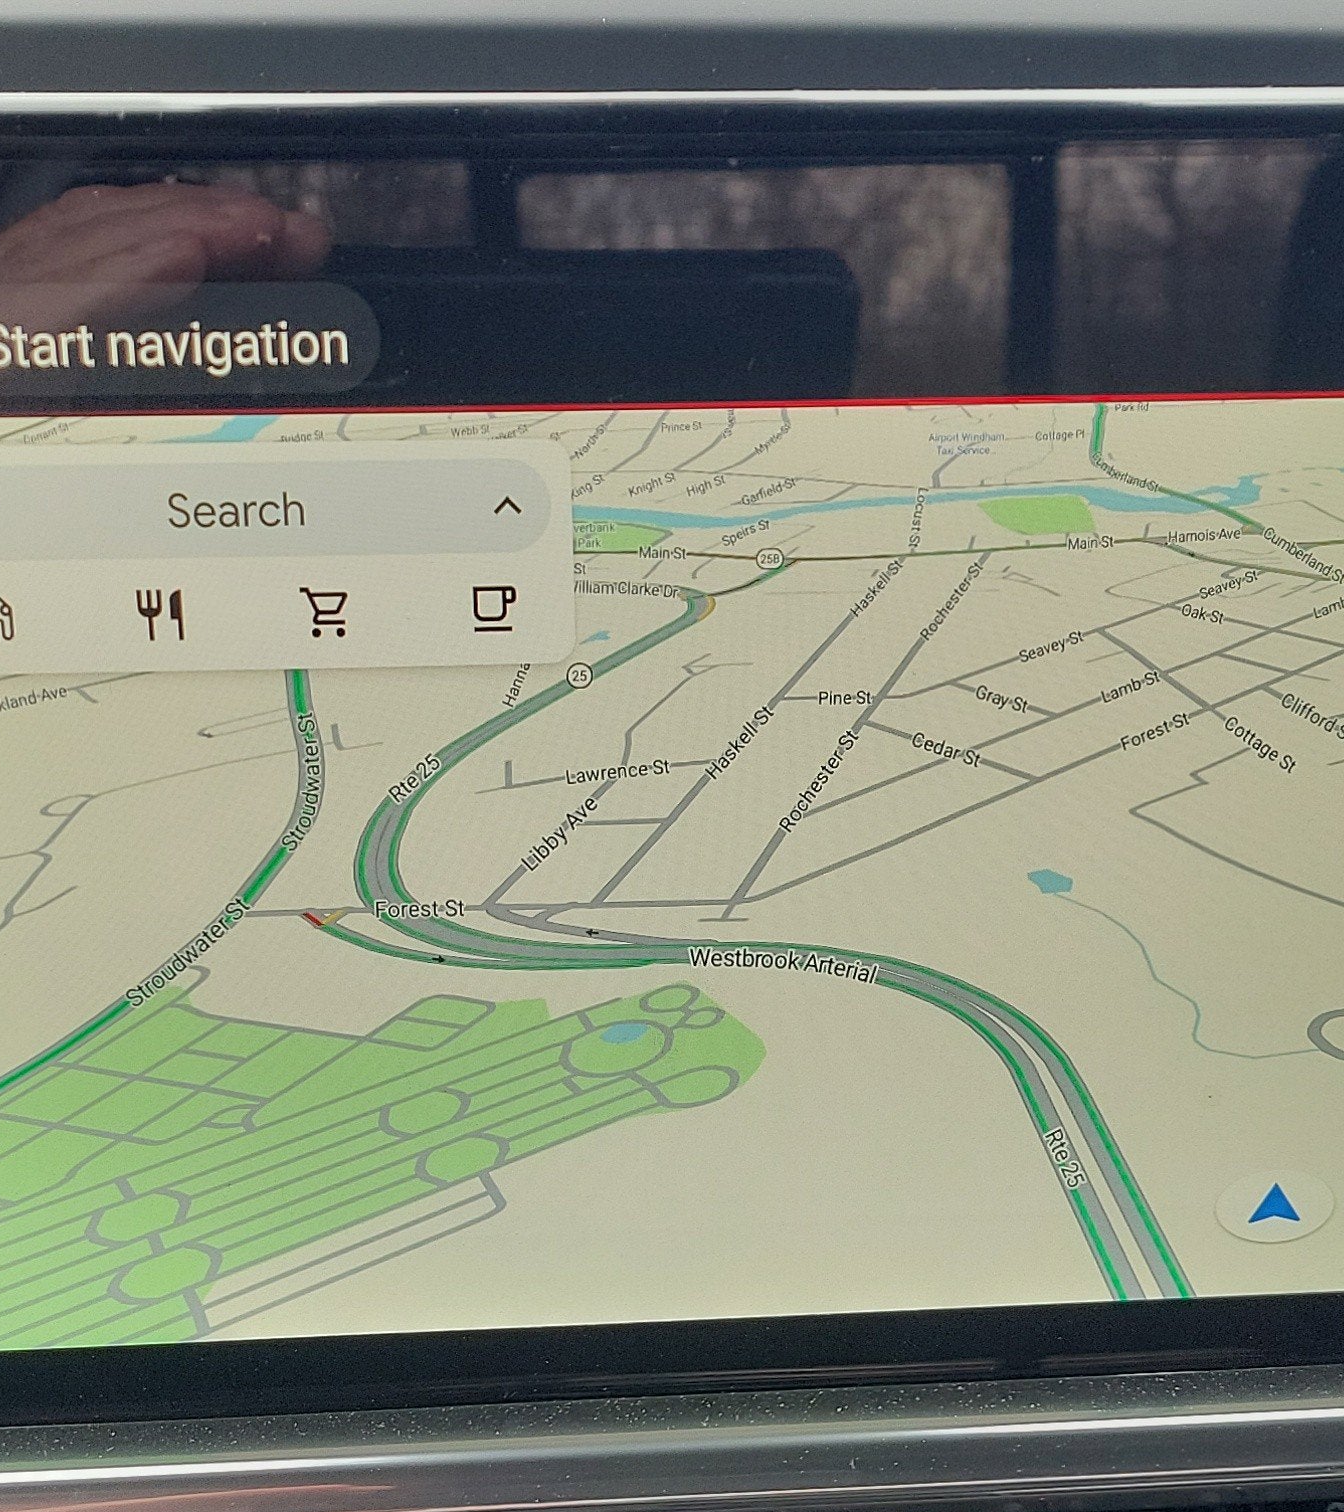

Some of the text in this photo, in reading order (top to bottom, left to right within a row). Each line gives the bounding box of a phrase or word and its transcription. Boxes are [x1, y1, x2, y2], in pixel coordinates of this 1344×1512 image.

[108, 321, 349, 377] navigation
[451, 426, 478, 437] Webb
[661, 421, 702, 433] Prince St
[575, 433, 598, 460] North
[592, 474, 605, 486] St
[628, 472, 675, 497] Knight St
[1092, 453, 1147, 489] Cumberland
[687, 475, 726, 497] High St
[741, 477, 796, 505] Garfield St
[167, 491, 306, 528] Search
[911, 486, 928, 534] Locust
[578, 538, 601, 548] Park
[722, 520, 770, 546] Speirs St
[1067, 536, 1114, 550] Main St
[1168, 528, 1241, 542] Harnois Ave
[639, 546, 686, 559] Main St
[760, 553, 780, 564] 25B
[1263, 528, 1331, 577] Cumberland
[574, 563, 586, 574] St
[618, 582, 678, 598] Clarke Dr
[849, 559, 904, 616] Haskell St
[1199, 570, 1259, 599] Seavey St
[920, 562, 983, 640] Rochester St
[1181, 603, 1224, 624] Oak St
[1019, 630, 1084, 663] Seavey St
[572, 670, 587, 682] 25
[1101, 670, 1160, 704] Lamb St
[40, 688, 68, 702] Ave
[818, 690, 872, 705] Pine St
[975, 685, 1028, 713] Gray St
[1281, 693, 1338, 733] Clifford
[705, 706, 775, 780] Haskell St
[1120, 712, 1189, 751] Forest St
[1224, 717, 1297, 773] Cottage St
[911, 733, 981, 767] Cedar St
[282, 712, 321, 851] Stroudwater St
[388, 754, 441, 804] Rte 25
[566, 760, 670, 785] Lawrence St
[779, 730, 859, 833] Rochester St
[521, 798, 598, 872] Libby Ave
[375, 900, 464, 919] Forest St
[125, 897, 250, 1007] Stroudwater St
[689, 948, 879, 985] Westbrook Arterial
[1045, 1129, 1085, 1188] Rte 25
